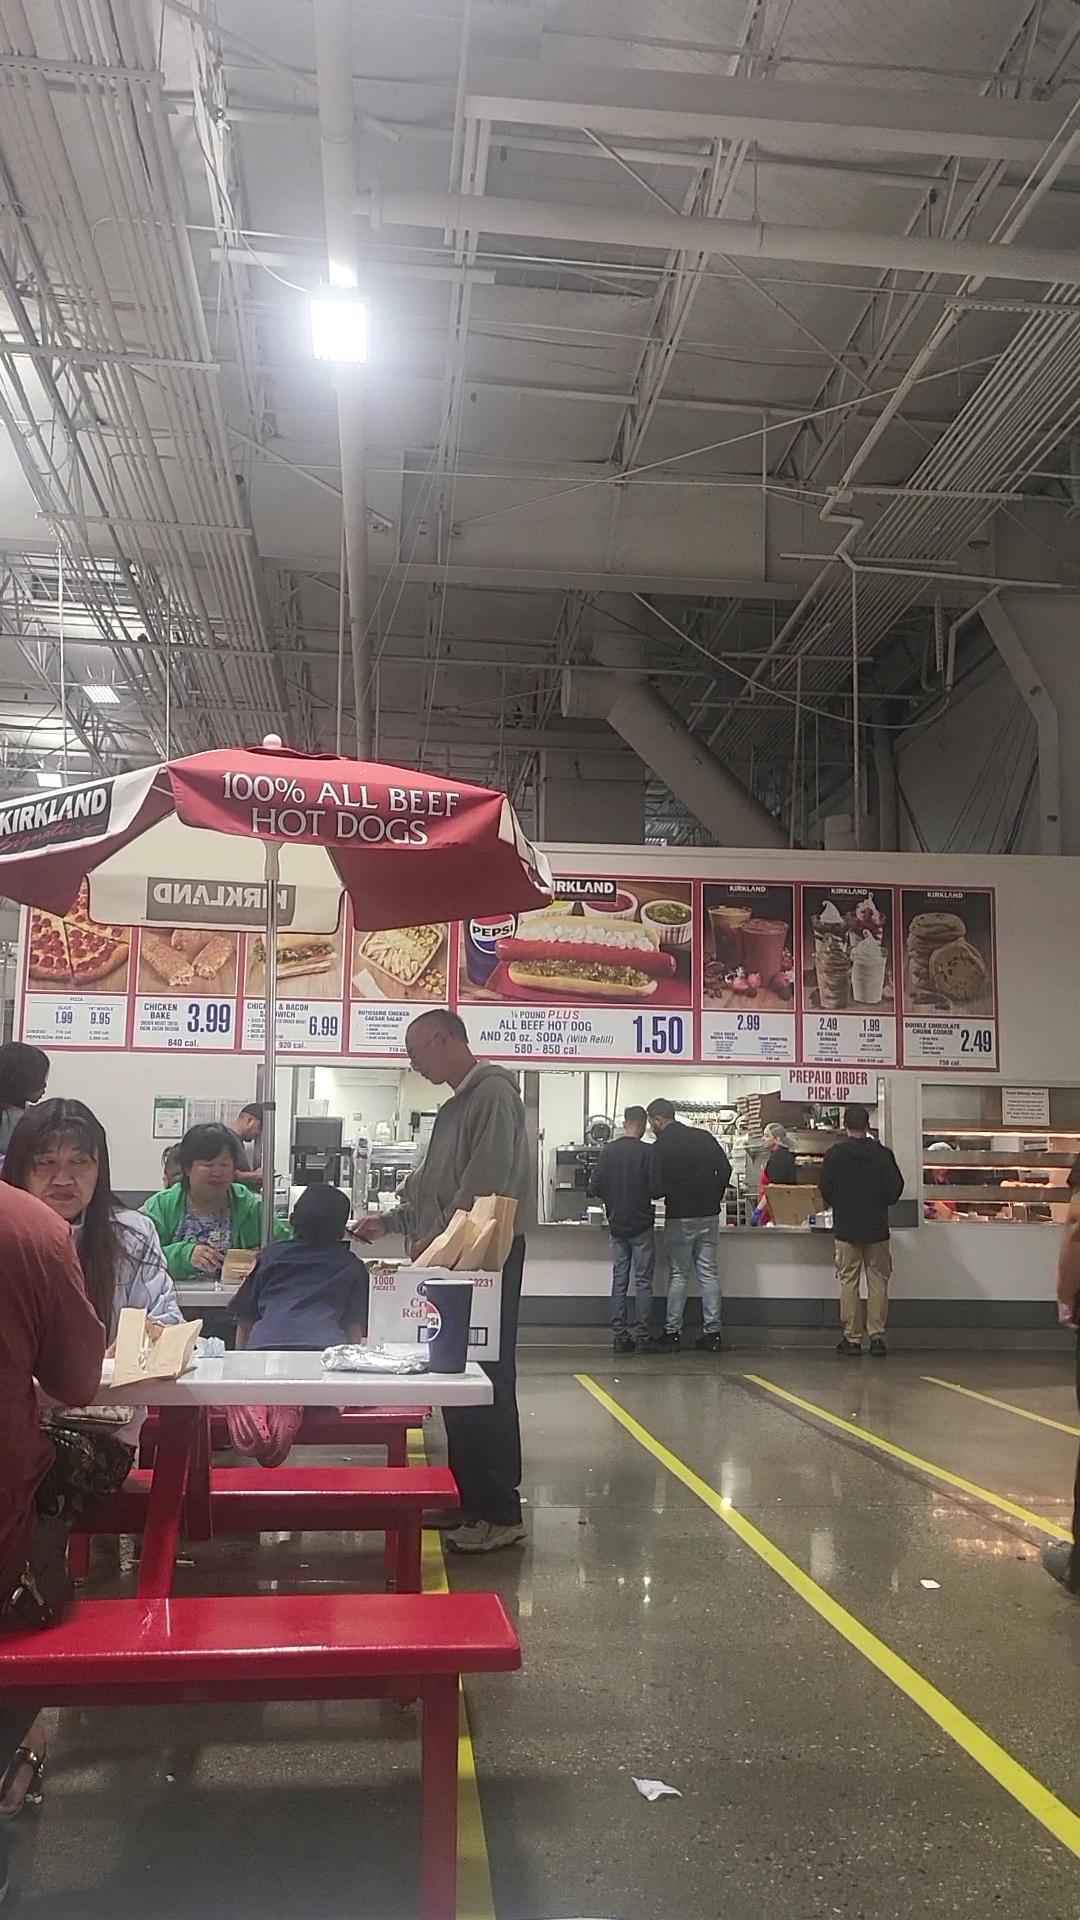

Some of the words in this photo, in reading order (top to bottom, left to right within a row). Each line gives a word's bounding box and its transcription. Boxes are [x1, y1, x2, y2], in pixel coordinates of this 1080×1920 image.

[222, 771, 306, 803] 100%
[316, 782, 379, 809] ALL
[388, 787, 460, 818] BEEF
[0, 788, 107, 836] KIRKLAND
[251, 807, 326, 837] HOT
[336, 811, 428, 845] DOGS
[552, 880, 614, 893] IRKLAND
[927, 891, 963, 899] KIRKLAND
[472, 924, 514, 937] PEPSI
[144, 1002, 178, 1011] CHICKEN
[279, 1003, 284, 1011] &
[55, 1011, 73, 1024] 1.99
[90, 1012, 111, 1025] 9.95
[150, 1012, 171, 1020] BAKE
[187, 1003, 231, 1033] 3.99
[519, 1010, 546, 1019] POUND
[547, 1010, 580, 1020] PLUS
[309, 1015, 338, 1036] 6.99
[499, 1020, 518, 1030] ALL
[520, 1020, 545, 1030] BEEF
[547, 1021, 568, 1031] HOT
[570, 1021, 592, 1032] DOG
[737, 1014, 760, 1031] 2.99
[819, 1017, 838, 1031] 2.49
[862, 1019, 880, 1032] 1.99
[480, 1031, 501, 1041] AND
[504, 1031, 516, 1042] 20
[519, 1033, 533, 1042] oz.
[536, 1032, 564, 1043] SODA
[566, 1034, 588, 1044] (With
[590, 1035, 614, 1045] Refill)
[632, 1015, 683, 1054] 1.50
[960, 1029, 992, 1053] 2.49
[167, 1038, 182, 1046] 840
[184, 1039, 200, 1047] cal.
[514, 1043, 533, 1054] 580
[542, 1044, 561, 1054] 850
[563, 1044, 581, 1055] cal.
[789, 1069, 832, 1084] PREPAID
[835, 1070, 868, 1086] ORDER
[807, 1086, 850, 1100] PICK-UP
[374, 1276, 395, 1285] 1000
[402, 1308, 423, 1318] Red
